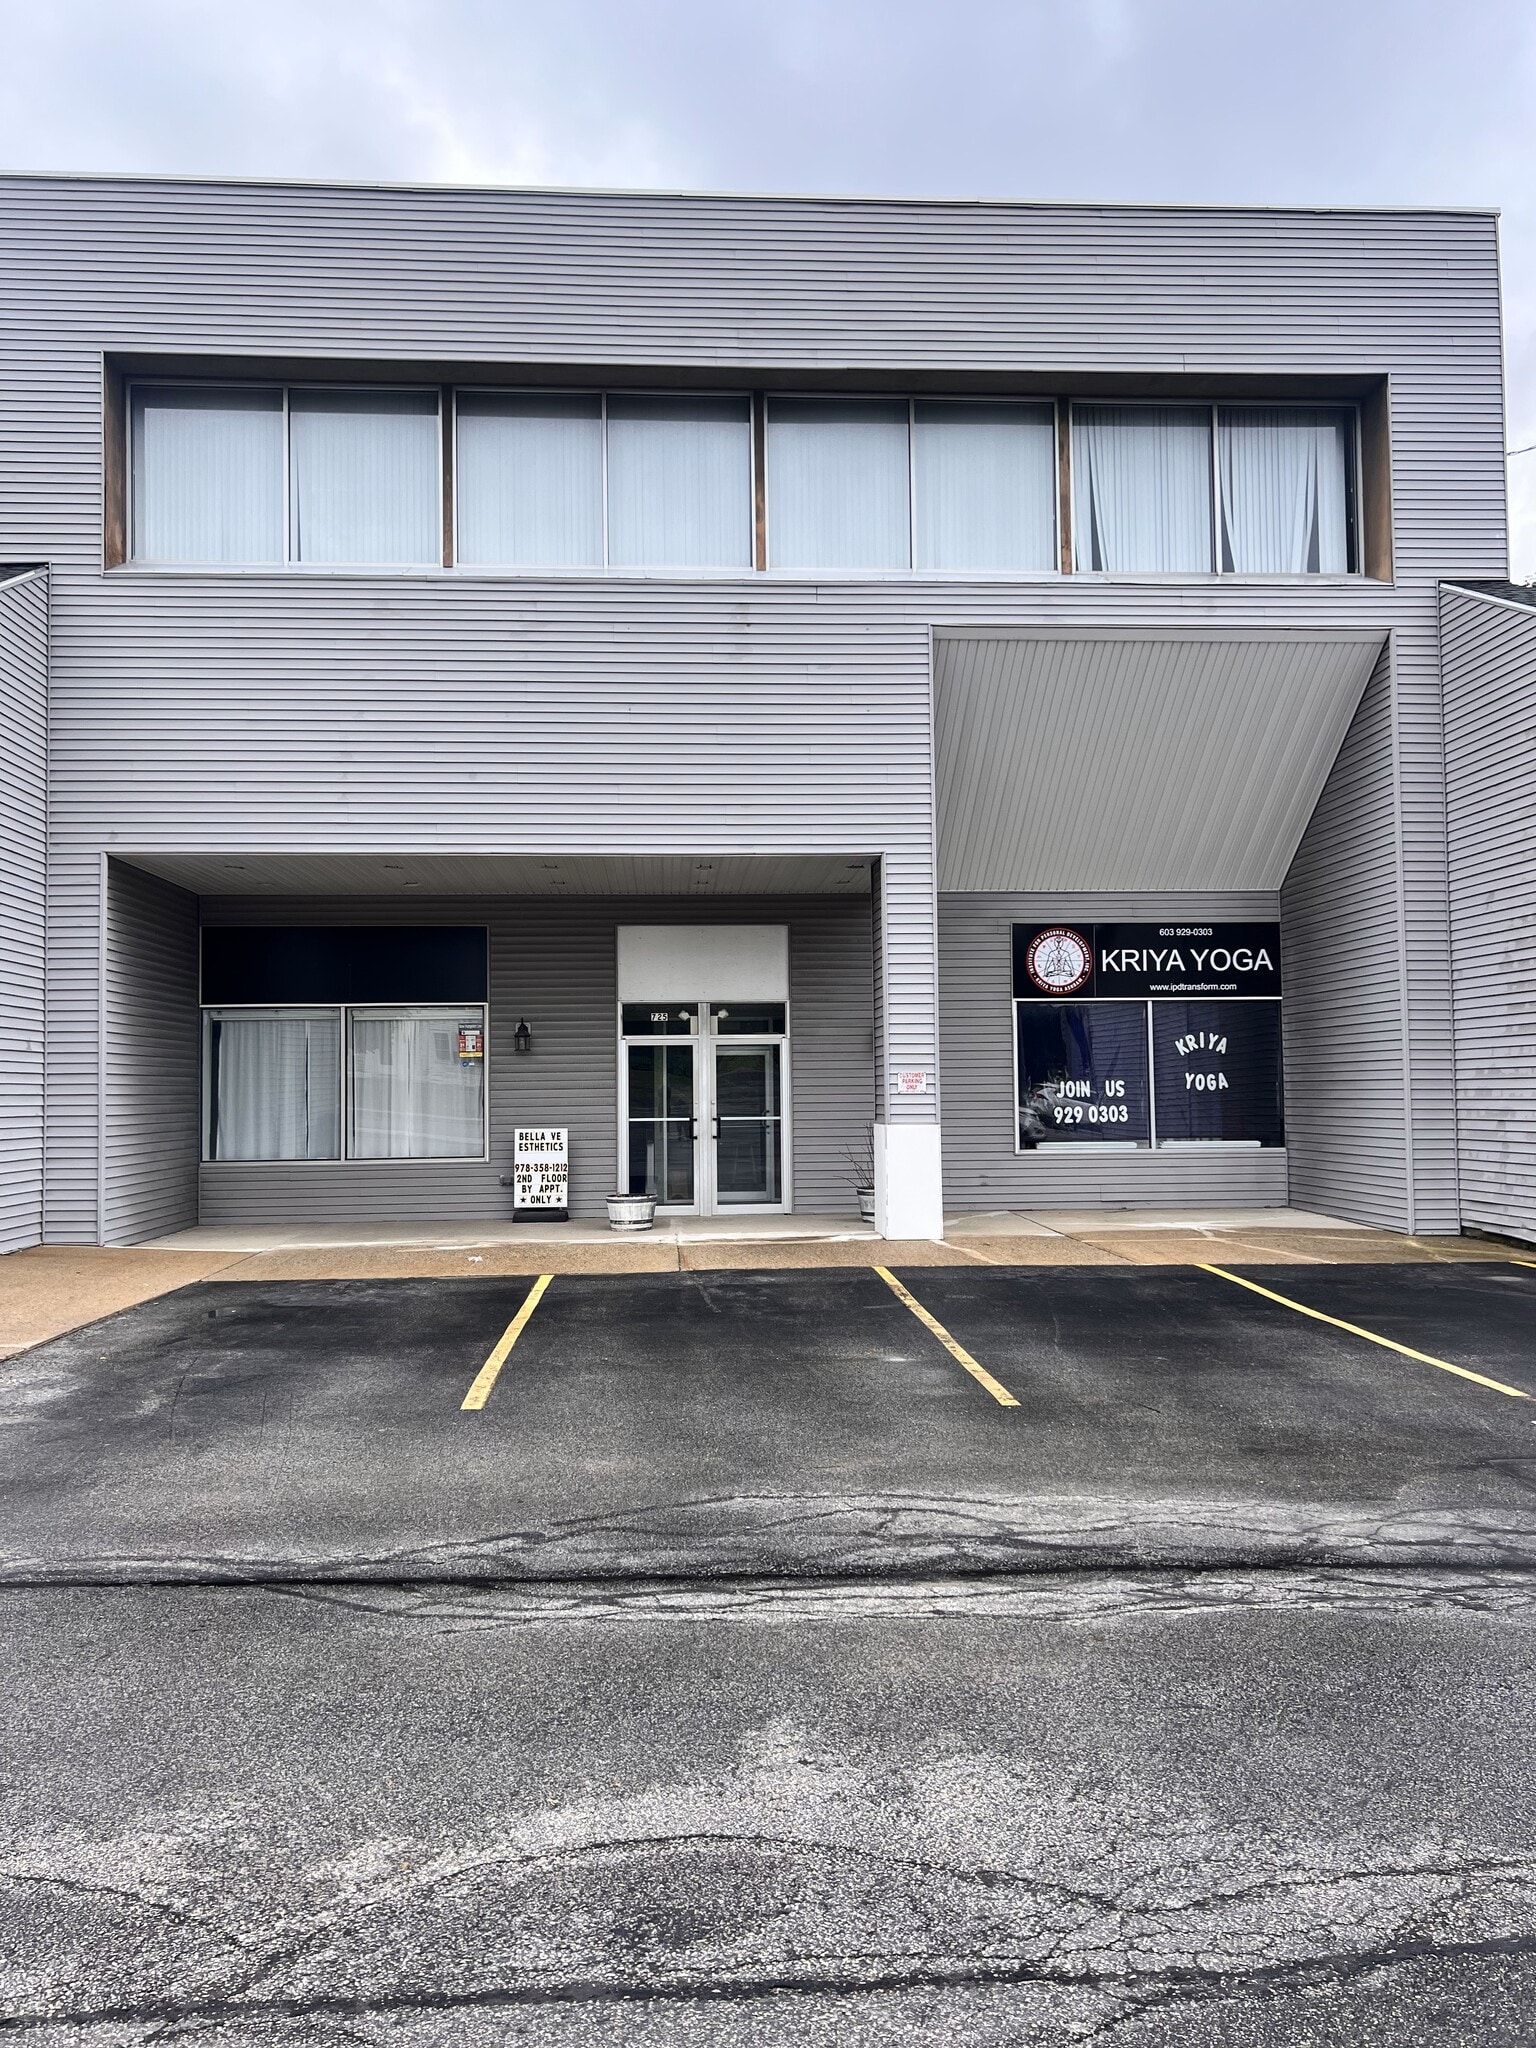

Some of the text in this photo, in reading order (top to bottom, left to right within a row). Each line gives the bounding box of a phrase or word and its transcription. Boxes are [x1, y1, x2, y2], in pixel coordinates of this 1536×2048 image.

[1159, 928, 1213, 936] 603 929-0303
[1101, 948, 1274, 972] KRIYA YOGA
[1149, 983, 1237, 992] www.ipdtransform.com
[1174, 1031, 1227, 1056] KRIYA
[1185, 1072, 1229, 1091] YOGA
[1056, 1079, 1126, 1098] JOIN US
[1053, 1104, 1129, 1124] 929 0303
[519, 1132, 561, 1141] BELLA VE
[519, 1142, 564, 1152] ESTHETICS
[515, 1163, 568, 1173] 978-358-1212
[517, 1174, 568, 1183] 2ND FLOOR
[522, 1184, 563, 1194] BY APPT.
[530, 1195, 552, 1204] ONLY
